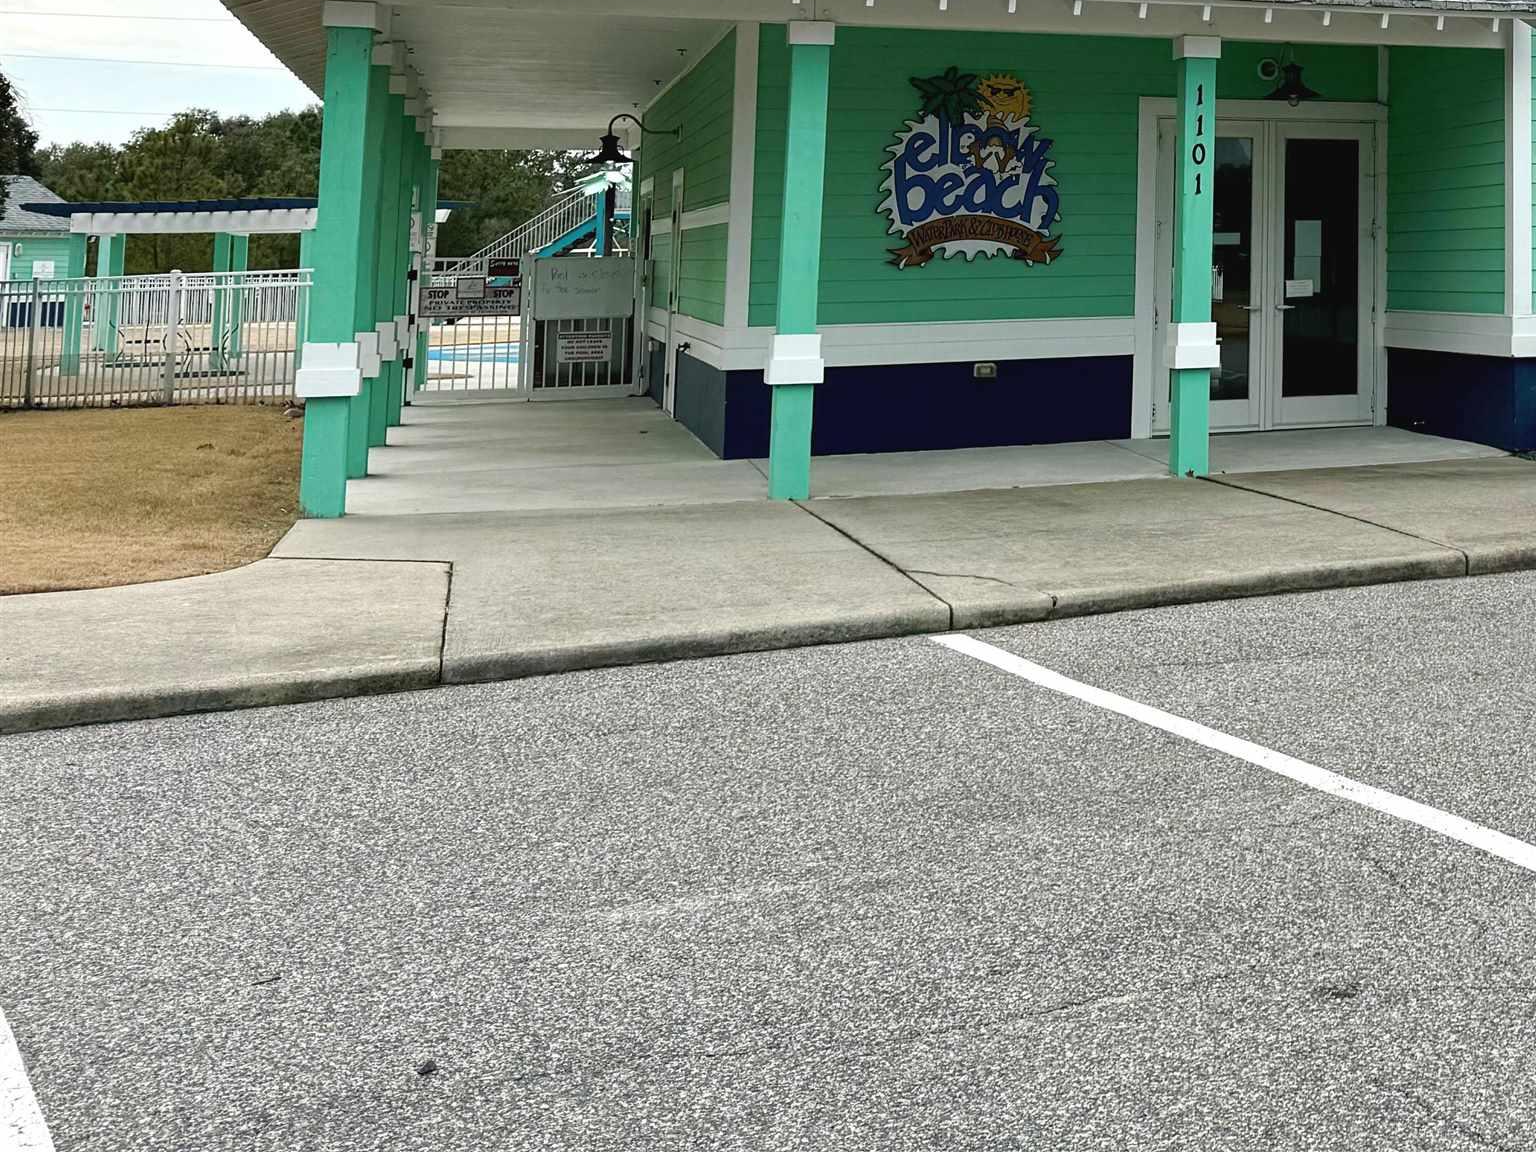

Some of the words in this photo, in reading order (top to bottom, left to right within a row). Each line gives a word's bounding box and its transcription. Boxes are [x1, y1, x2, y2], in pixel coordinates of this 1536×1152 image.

[1192, 83, 1206, 196] 1101
[894, 156, 1060, 231] beach
[428, 290, 450, 299] STOP
[493, 289, 514, 298] STOP
